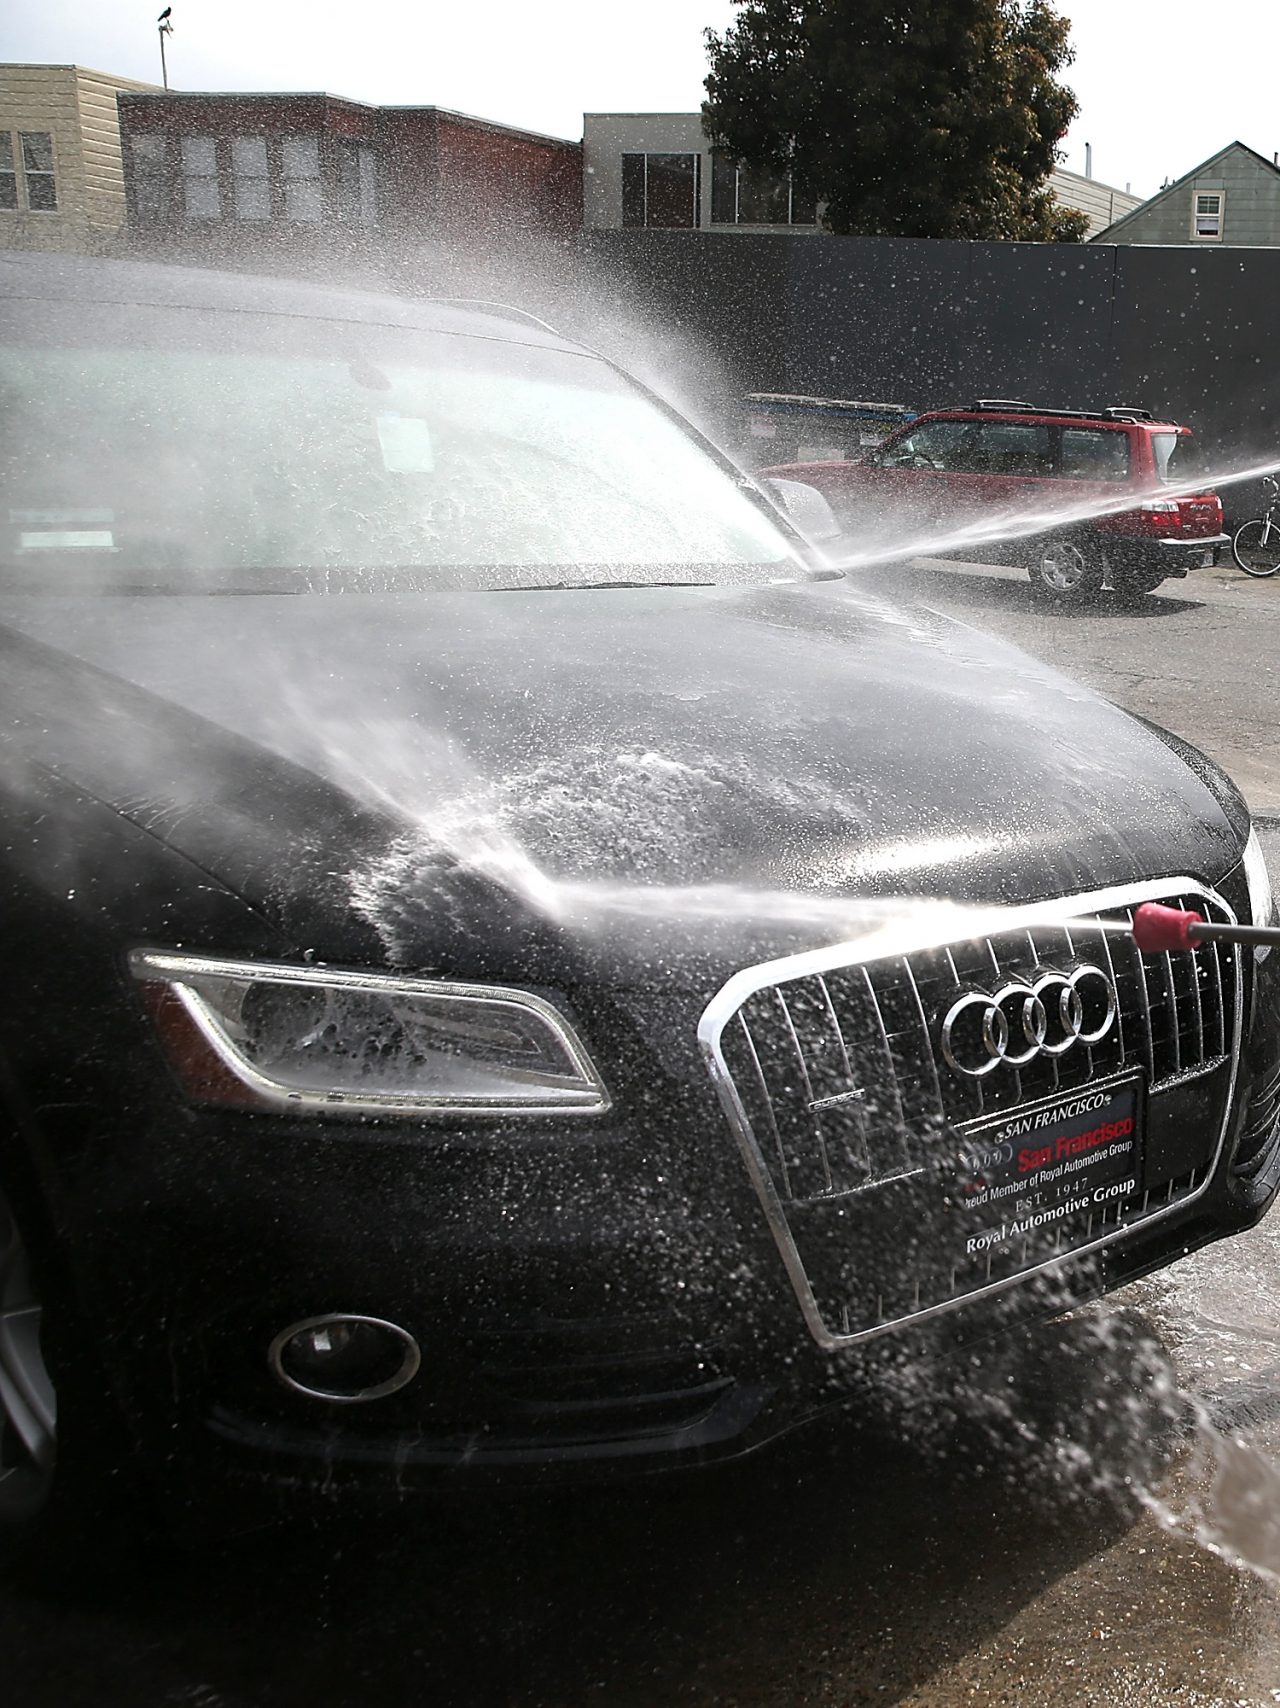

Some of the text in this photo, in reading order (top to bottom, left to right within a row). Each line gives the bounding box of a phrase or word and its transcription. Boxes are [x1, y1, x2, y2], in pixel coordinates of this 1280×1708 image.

[1004, 1093, 1104, 1139] SAN FRANCISCO
[1017, 1116, 1134, 1172] San Francisco
[965, 1187, 988, 1209] roud
[990, 1180, 1028, 1201] Member
[1029, 1172, 1039, 1187] of
[1040, 1164, 1063, 1182] Royal
[1063, 1148, 1108, 1175] Automotive
[1109, 1140, 1133, 1156] Group
[1016, 1177, 1088, 1213] EST. 1947
[966, 1178, 1135, 1254] Royal Automotive Group
